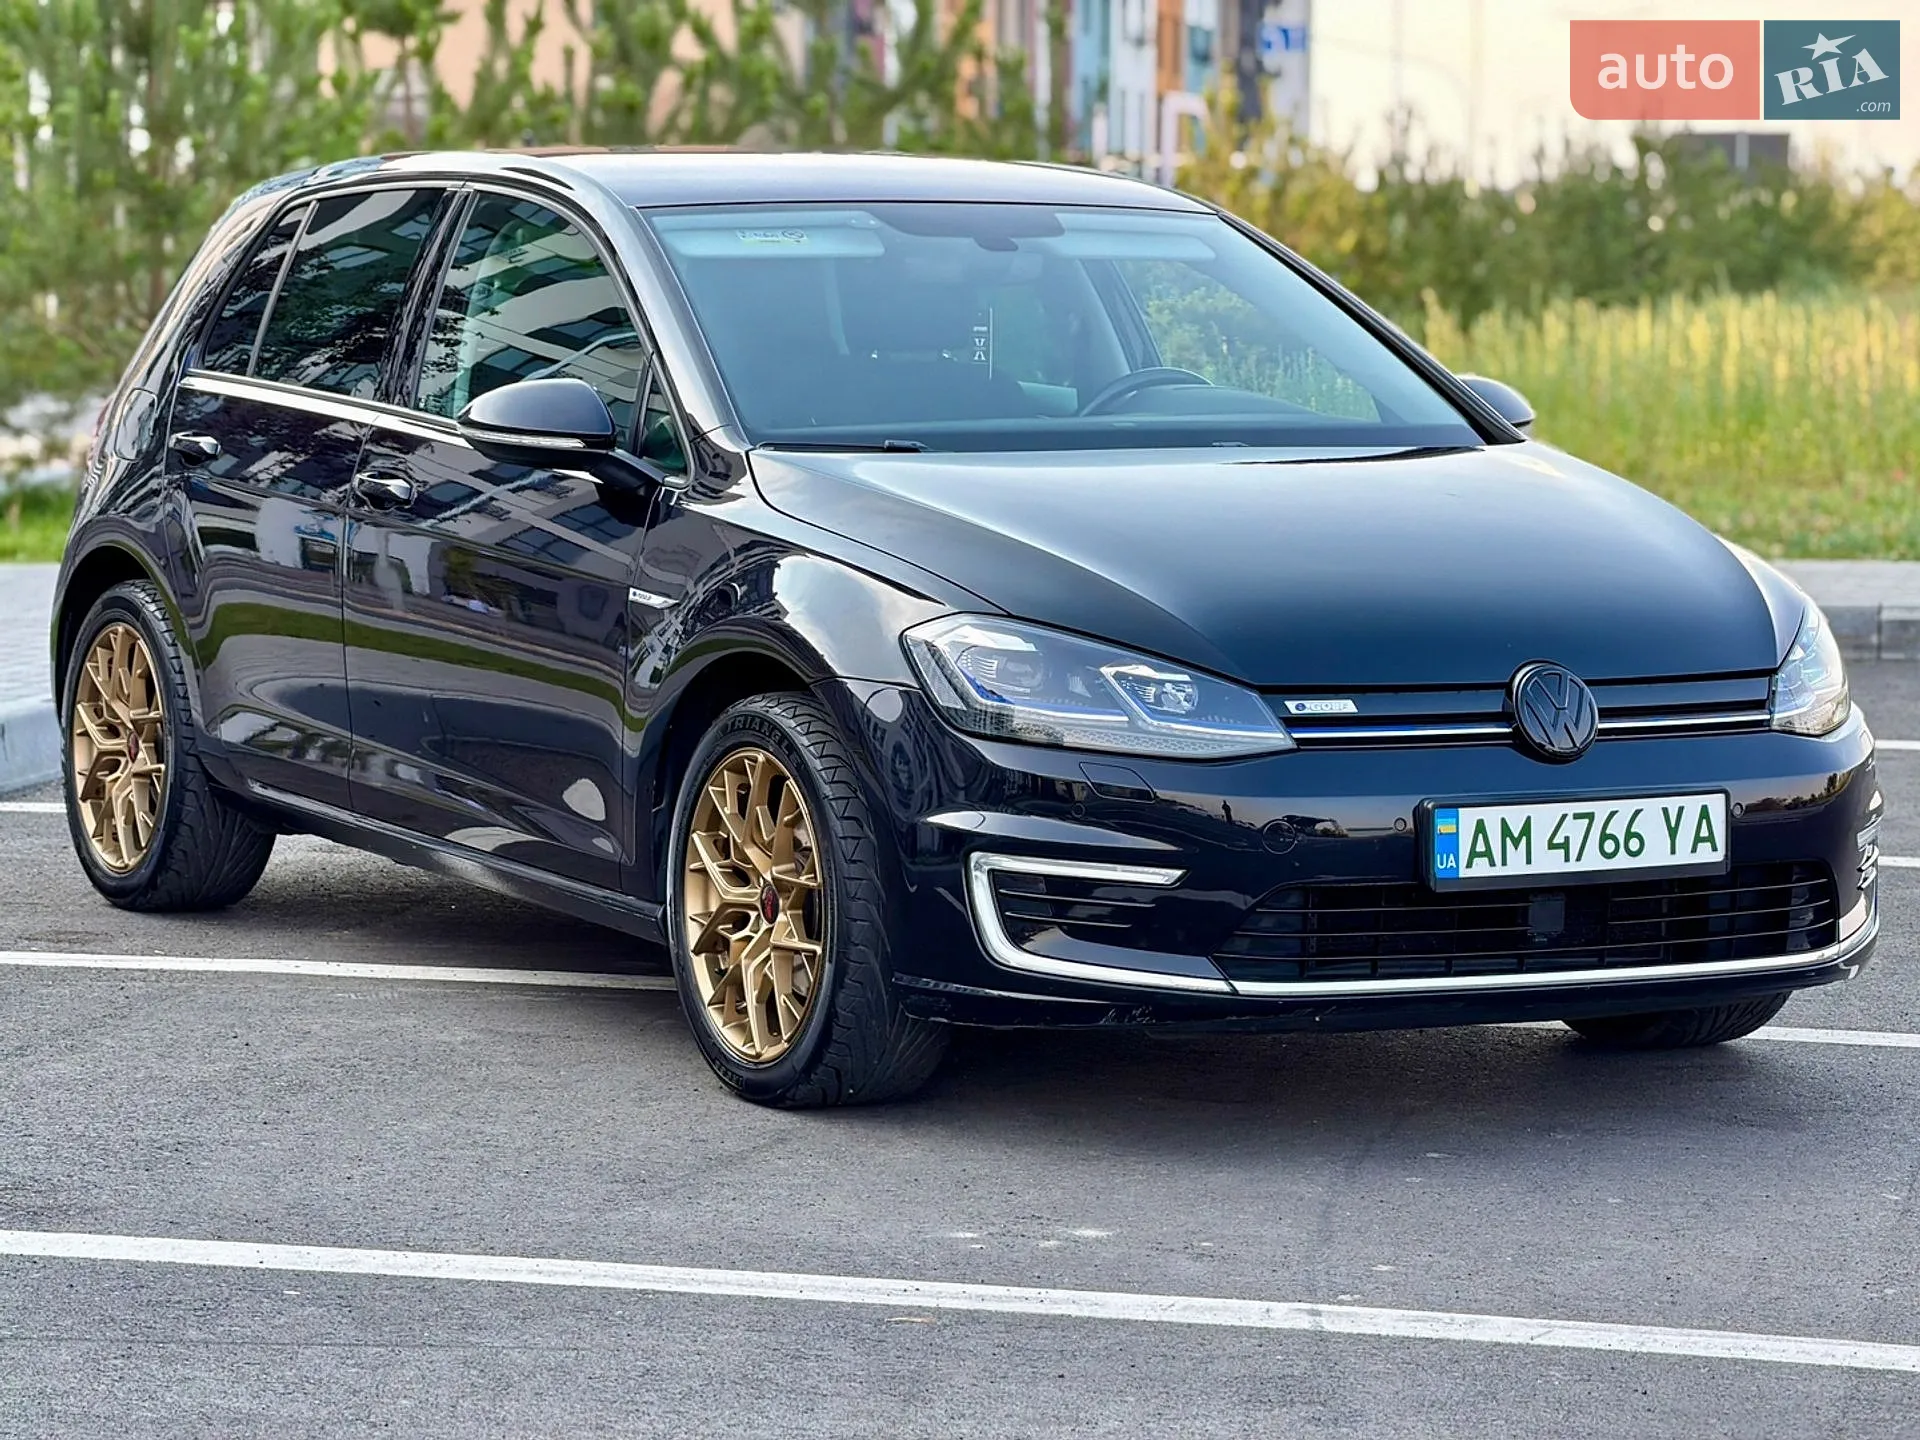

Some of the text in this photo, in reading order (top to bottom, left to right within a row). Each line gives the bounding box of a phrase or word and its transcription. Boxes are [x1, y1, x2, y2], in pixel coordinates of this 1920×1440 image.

[726, 716, 801, 767] TRIANGLE
[1437, 853, 1457, 869] UA
[1465, 804, 1719, 869] AM 4766 YA
